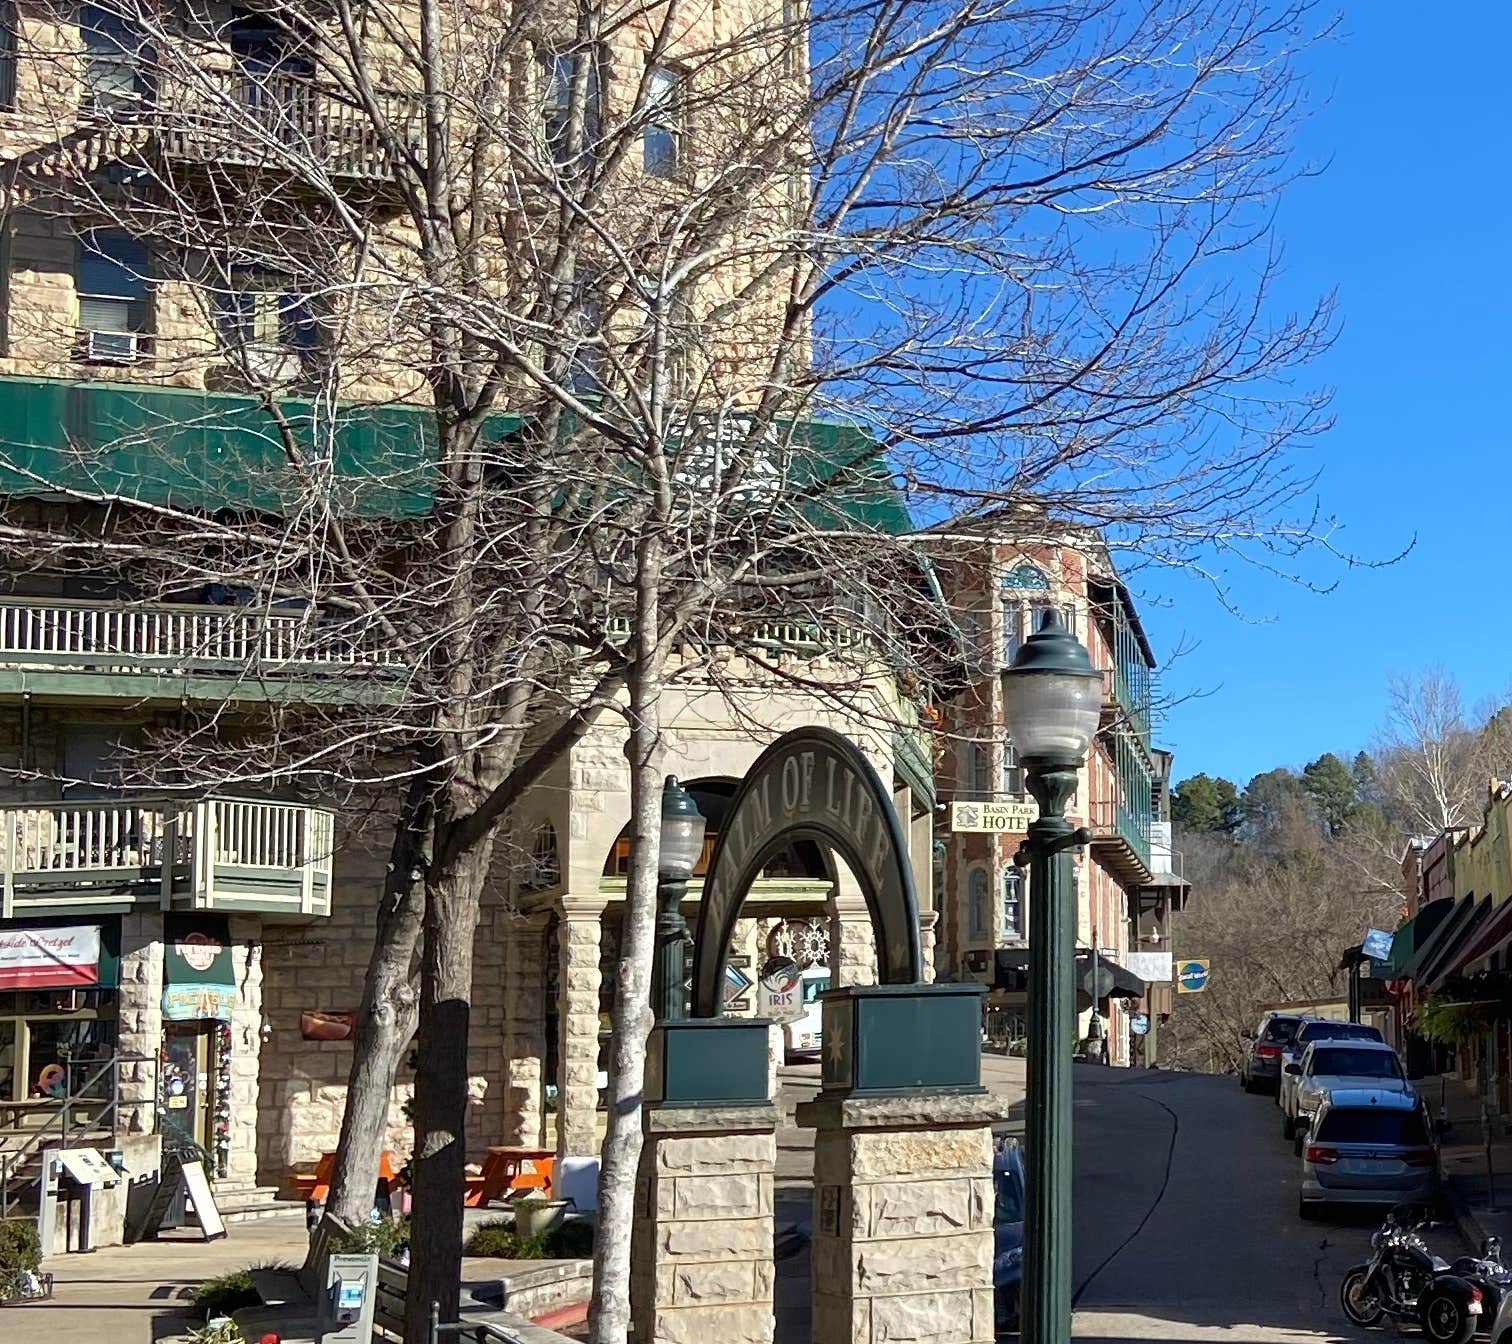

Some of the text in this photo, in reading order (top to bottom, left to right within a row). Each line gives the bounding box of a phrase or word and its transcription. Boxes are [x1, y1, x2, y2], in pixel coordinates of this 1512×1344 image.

[709, 751, 890, 924] BALM OF LIFE
[768, 993, 793, 1006] IRIS
